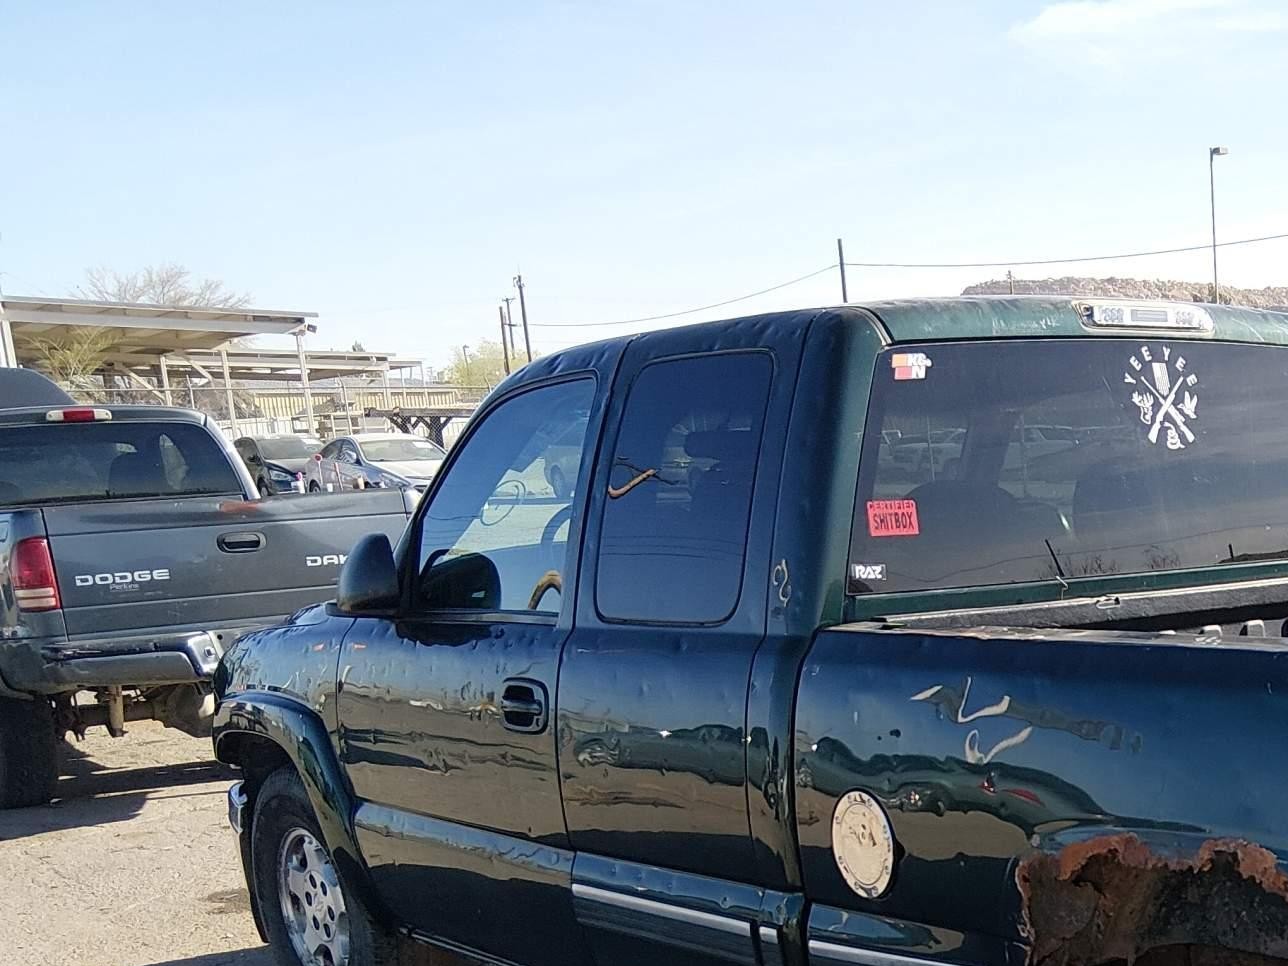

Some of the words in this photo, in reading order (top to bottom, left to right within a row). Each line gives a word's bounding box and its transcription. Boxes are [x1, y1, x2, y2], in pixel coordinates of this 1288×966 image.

[1124, 345, 1153, 385] YEE
[1162, 345, 1198, 387] YEE
[873, 511, 915, 530] SHITBOX
[75, 569, 170, 587] DODGE
